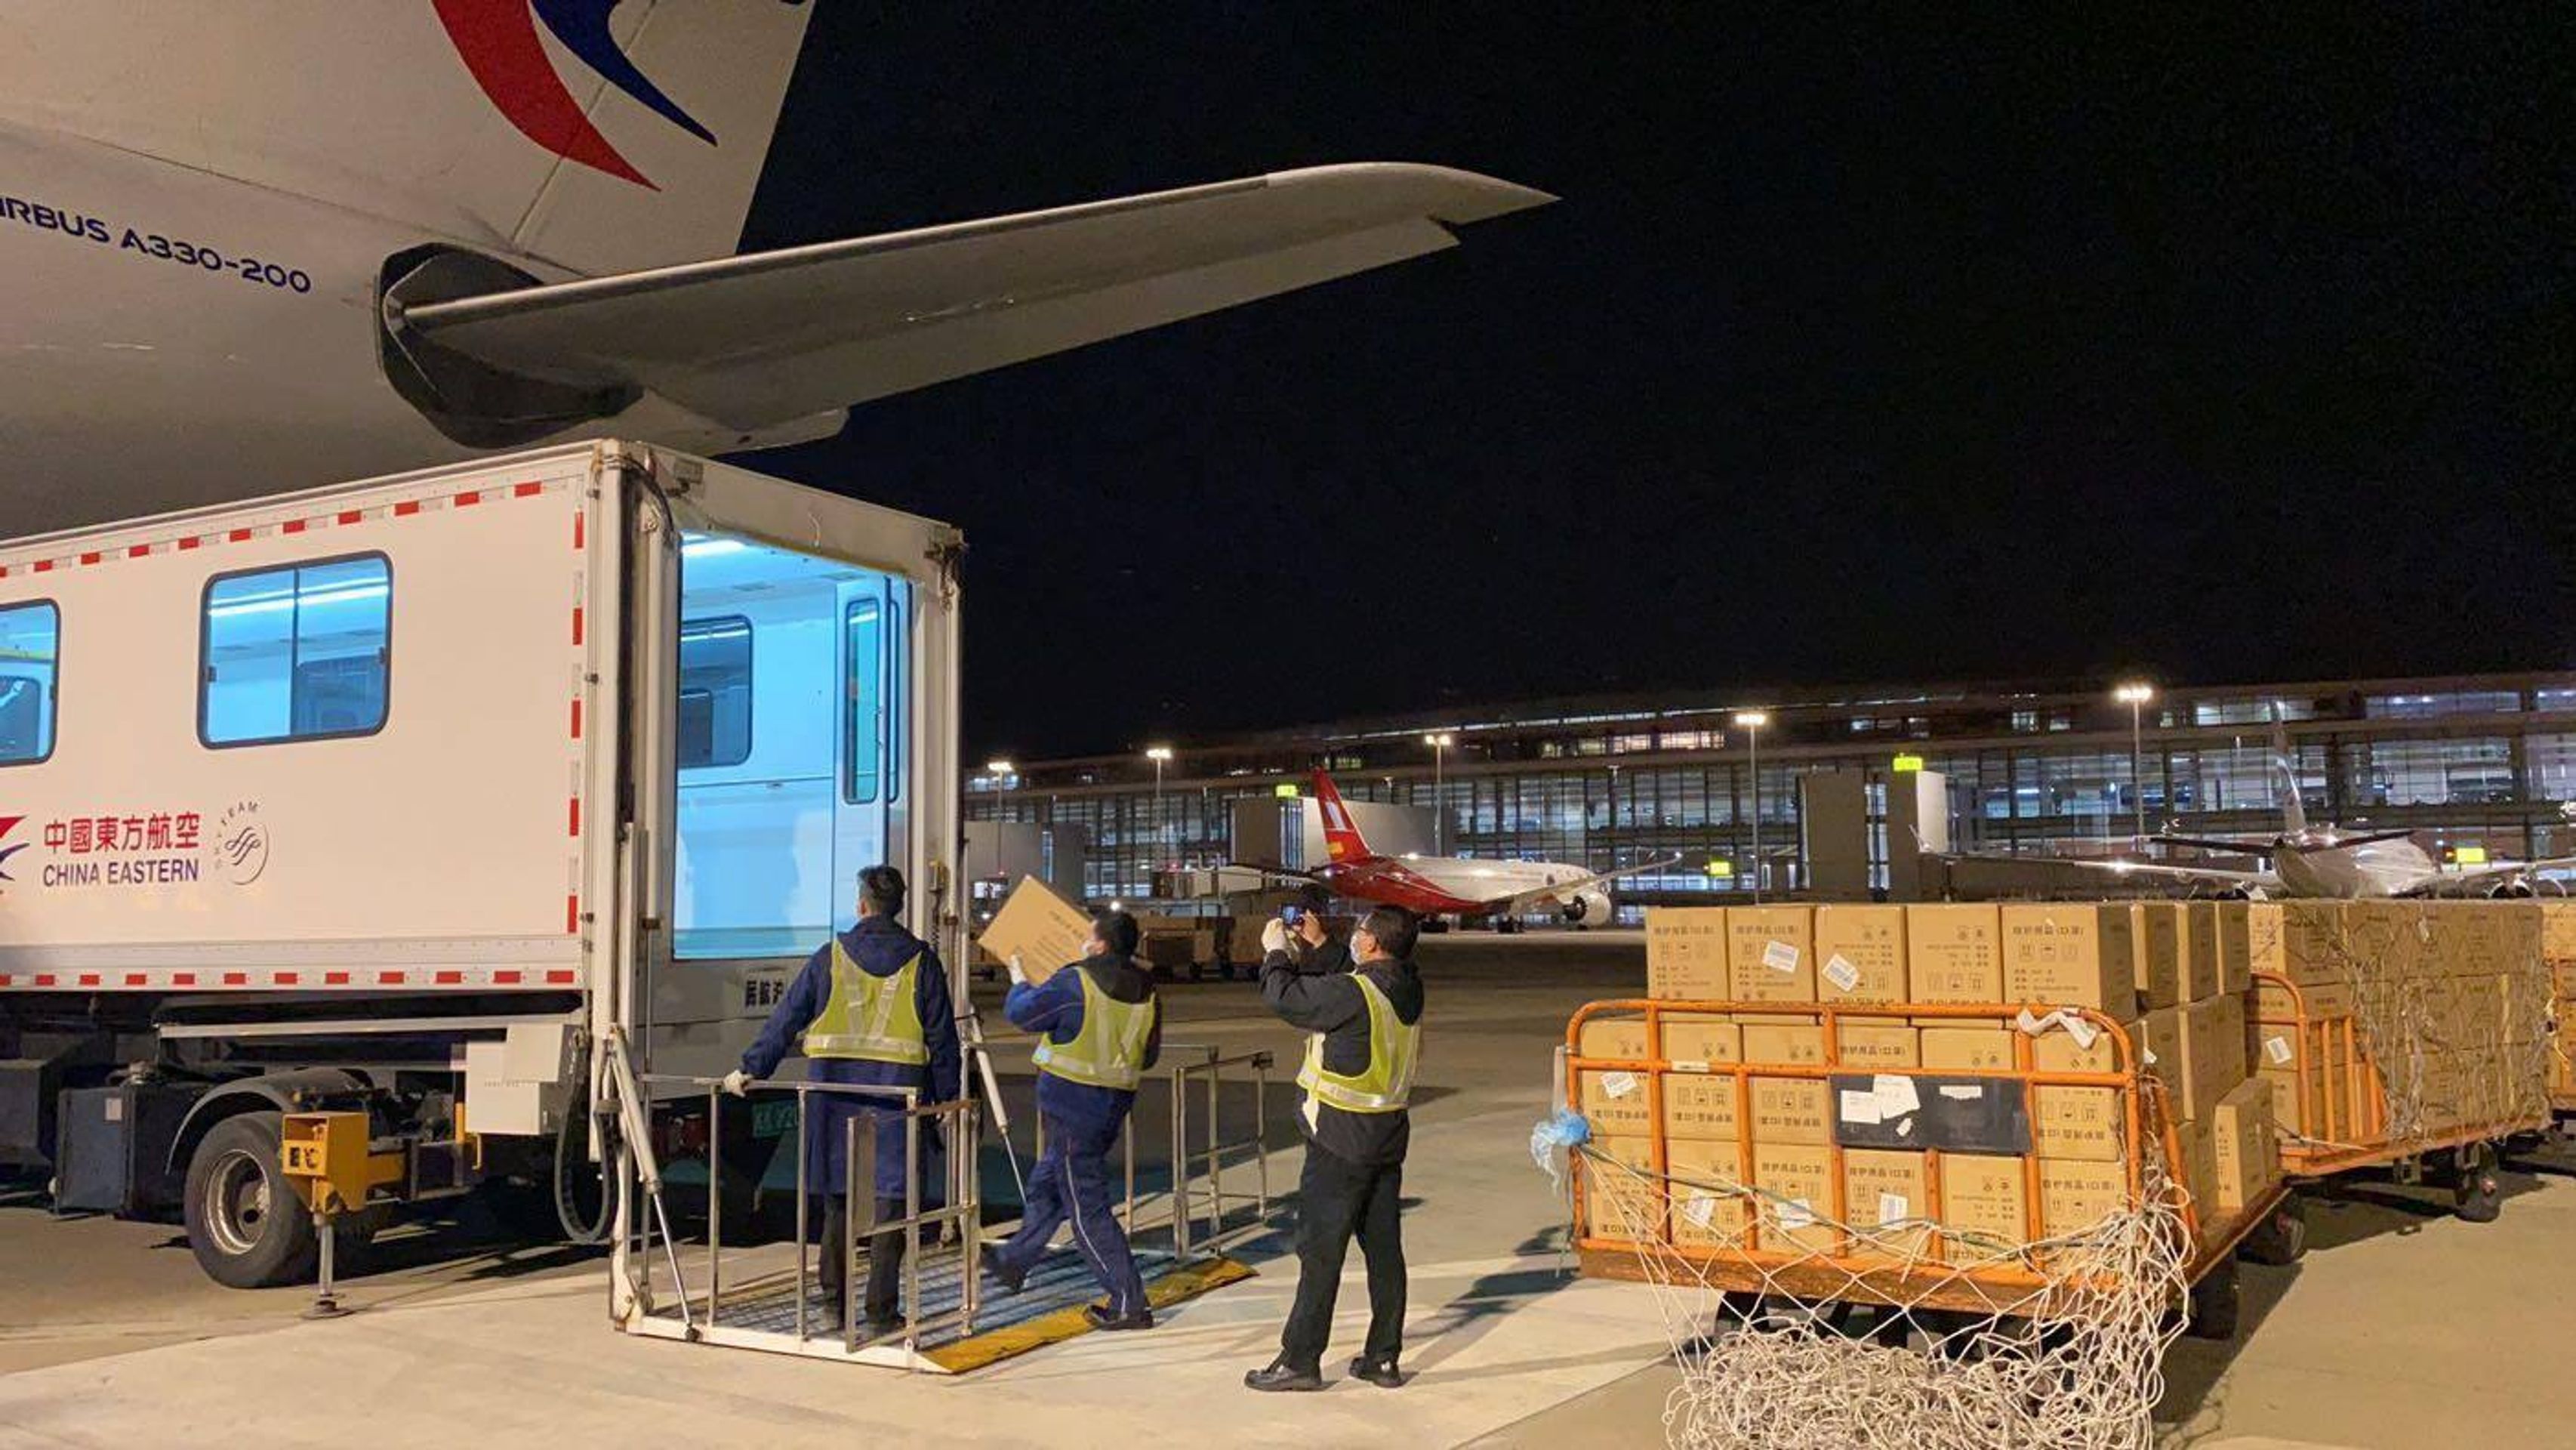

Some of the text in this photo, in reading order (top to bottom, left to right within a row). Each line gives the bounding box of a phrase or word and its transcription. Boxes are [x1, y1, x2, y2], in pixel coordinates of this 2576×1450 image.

[121, 228, 311, 293] A330-200
[44, 811, 200, 854] 中國東方航空
[43, 858, 199, 887] CHINA EASTERN
